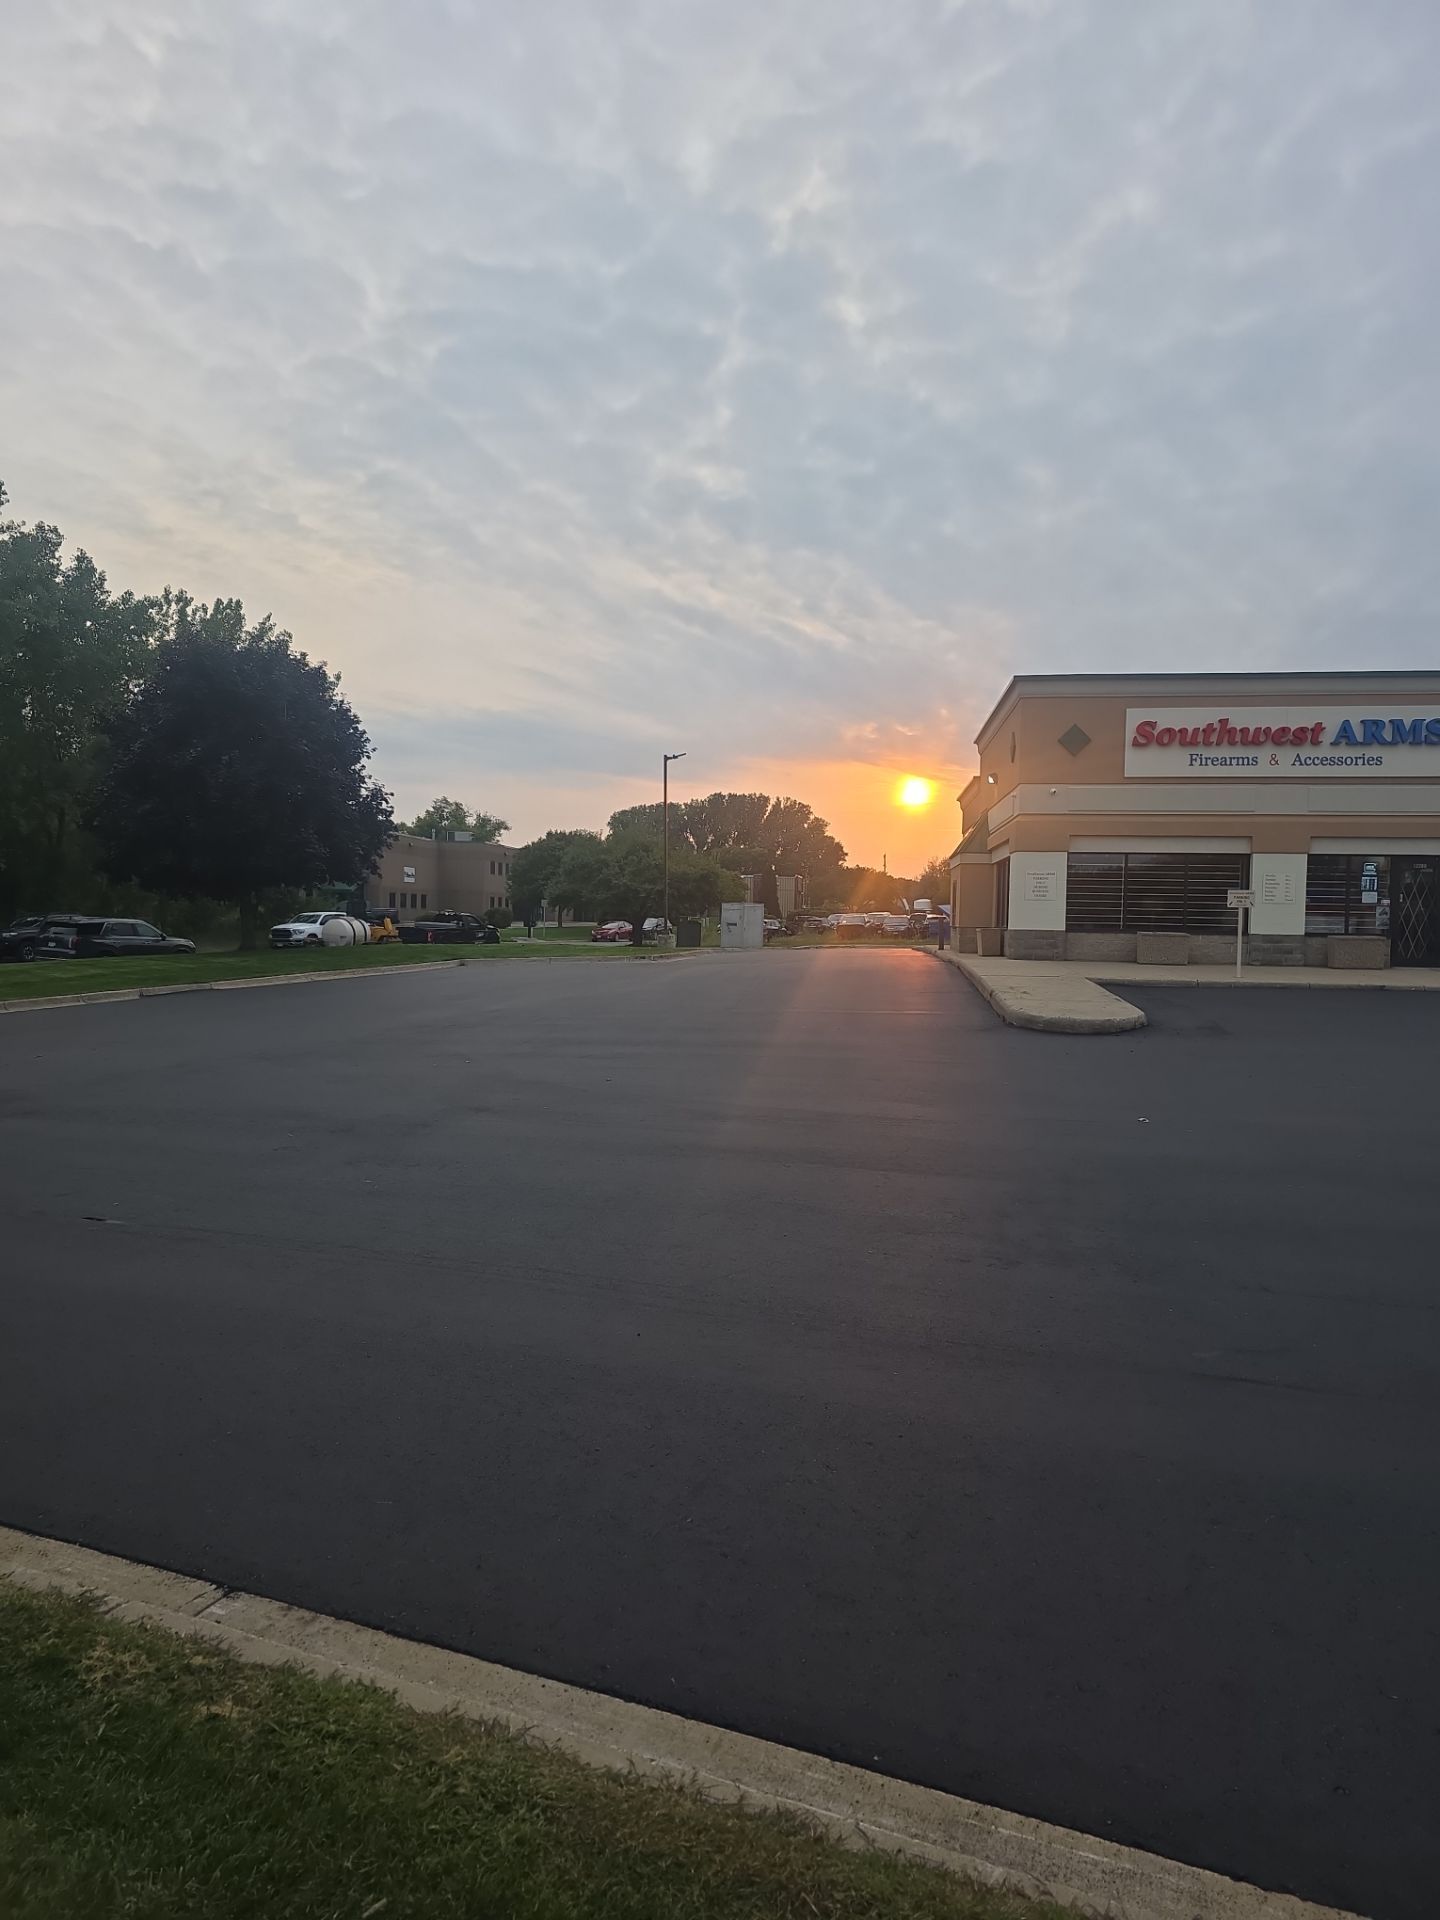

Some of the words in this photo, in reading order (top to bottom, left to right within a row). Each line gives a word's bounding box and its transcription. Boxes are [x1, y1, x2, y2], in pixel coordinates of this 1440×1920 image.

[1132, 718, 1326, 747] Southwest
[1330, 718, 1440, 746] ARMS
[1188, 753, 1259, 767] Firearms
[1269, 753, 1280, 767] &
[1291, 753, 1383, 767] Accessories
